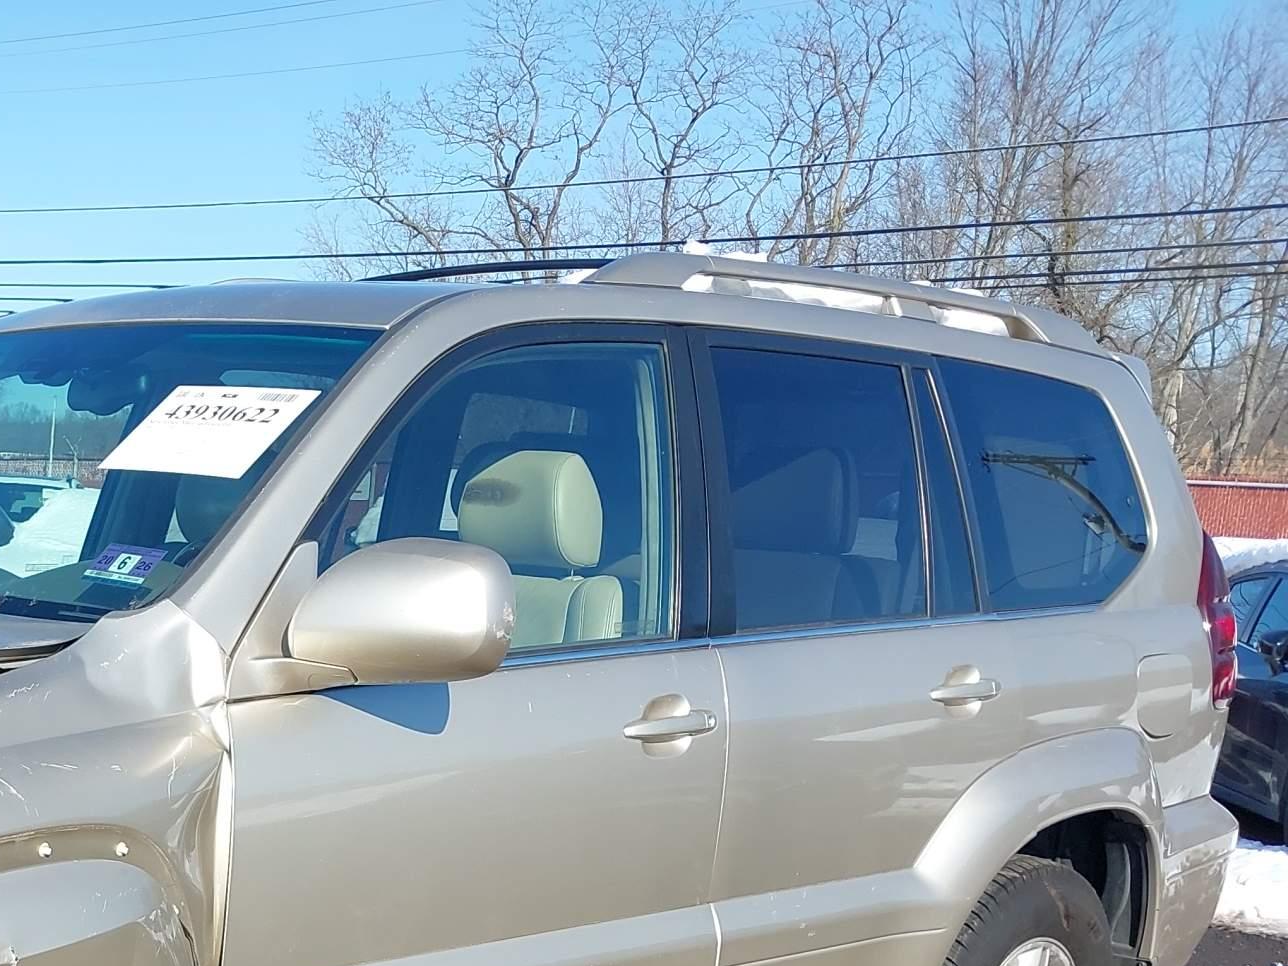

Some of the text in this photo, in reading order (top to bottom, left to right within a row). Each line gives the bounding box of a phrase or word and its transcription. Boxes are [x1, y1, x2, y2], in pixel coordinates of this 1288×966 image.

[165, 404, 280, 423] 43930622
[97, 554, 114, 566] 20
[117, 555, 132, 570] 6
[135, 560, 153, 572] 26
